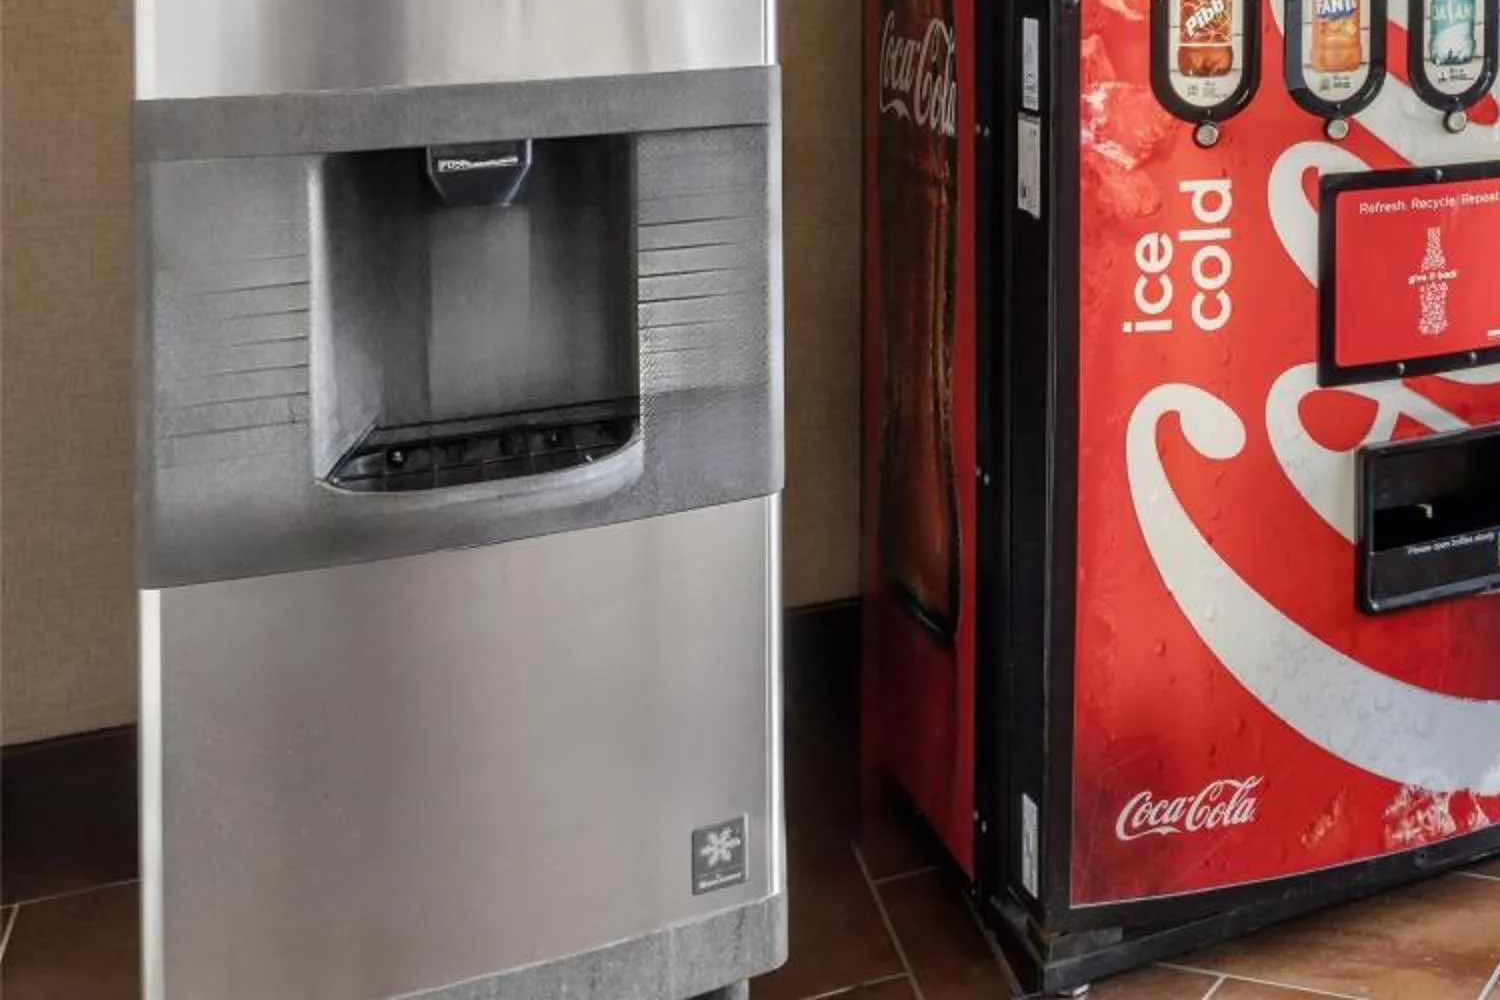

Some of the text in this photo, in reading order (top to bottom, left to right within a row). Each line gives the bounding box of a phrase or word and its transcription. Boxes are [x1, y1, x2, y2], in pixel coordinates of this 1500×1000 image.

[1123, 232, 1173, 333] ice
[1179, 179, 1232, 332] cold
[1116, 775, 1265, 841] Coca-Cola
